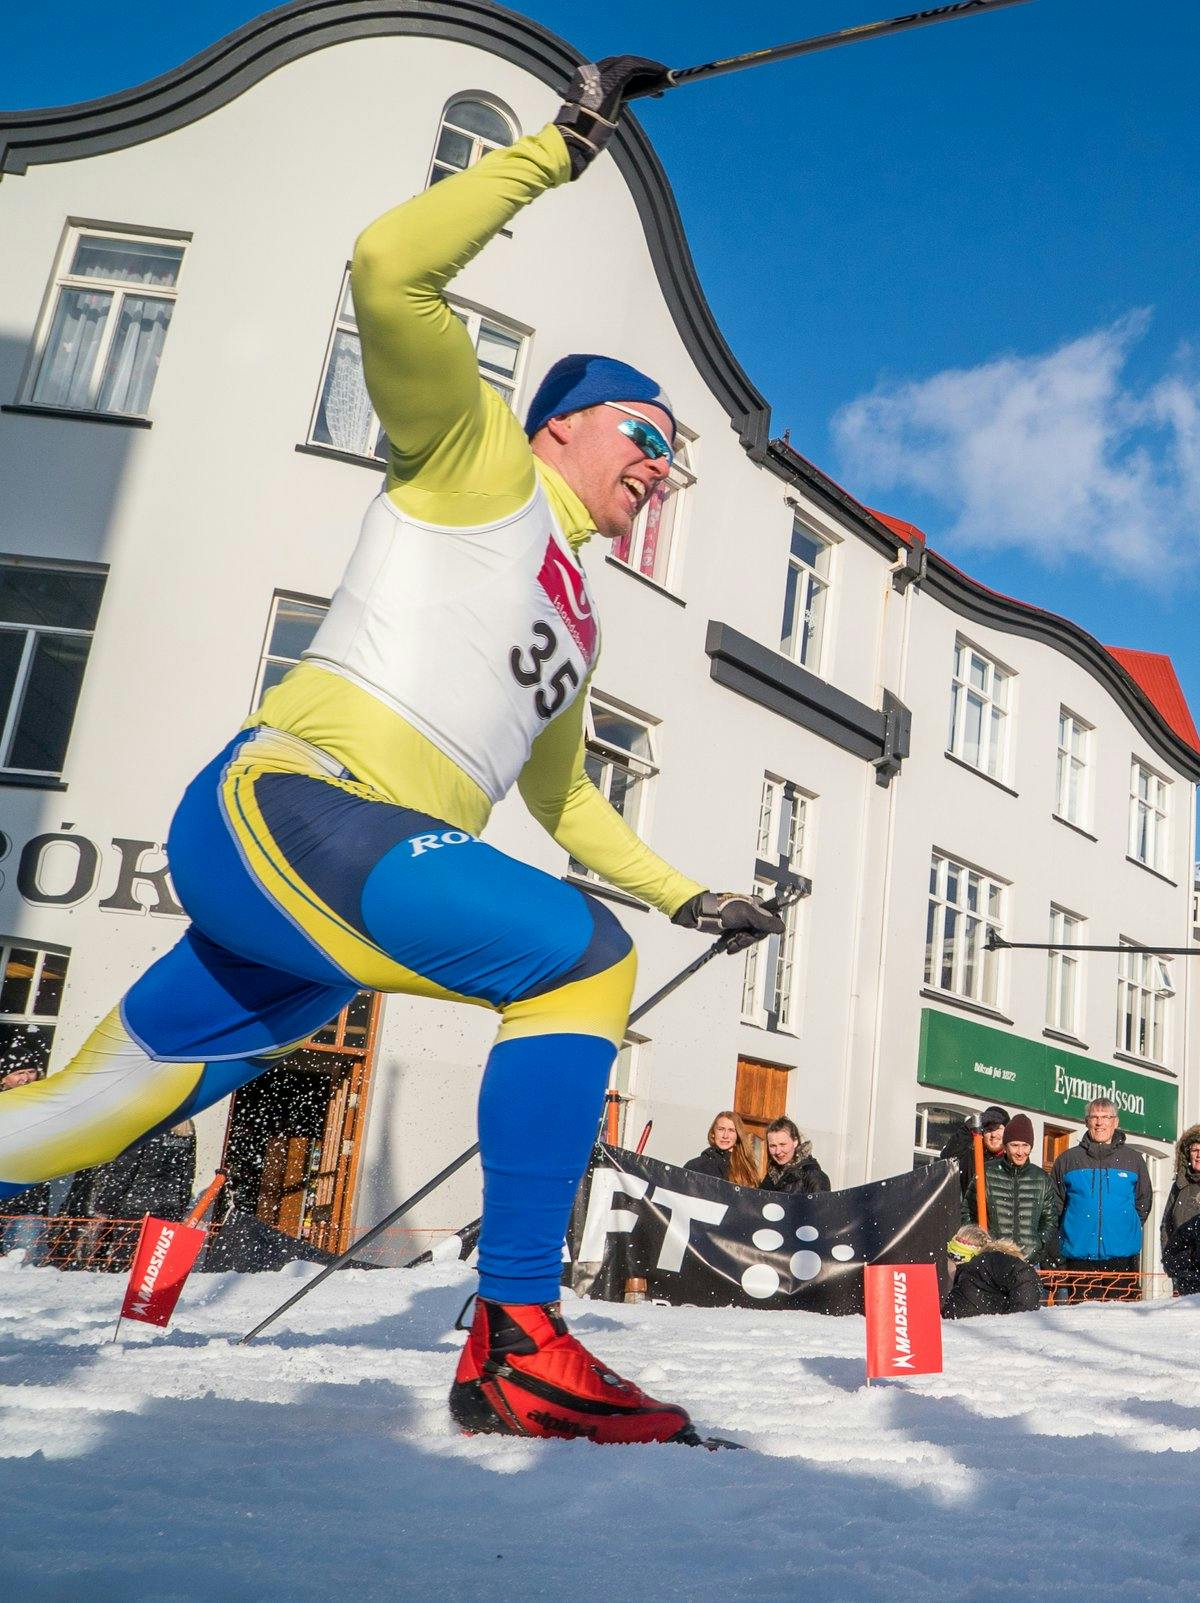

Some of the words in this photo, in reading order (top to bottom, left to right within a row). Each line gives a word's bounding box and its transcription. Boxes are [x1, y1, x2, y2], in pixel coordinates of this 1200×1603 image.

[511, 620, 579, 720] 35
[0, 822, 190, 921] ÓK
[1054, 1065, 1145, 1115] Eymundsson
[137, 1226, 175, 1302] MADSHUS
[561, 1168, 730, 1273] FT
[893, 1271, 911, 1354] MADSHUS
